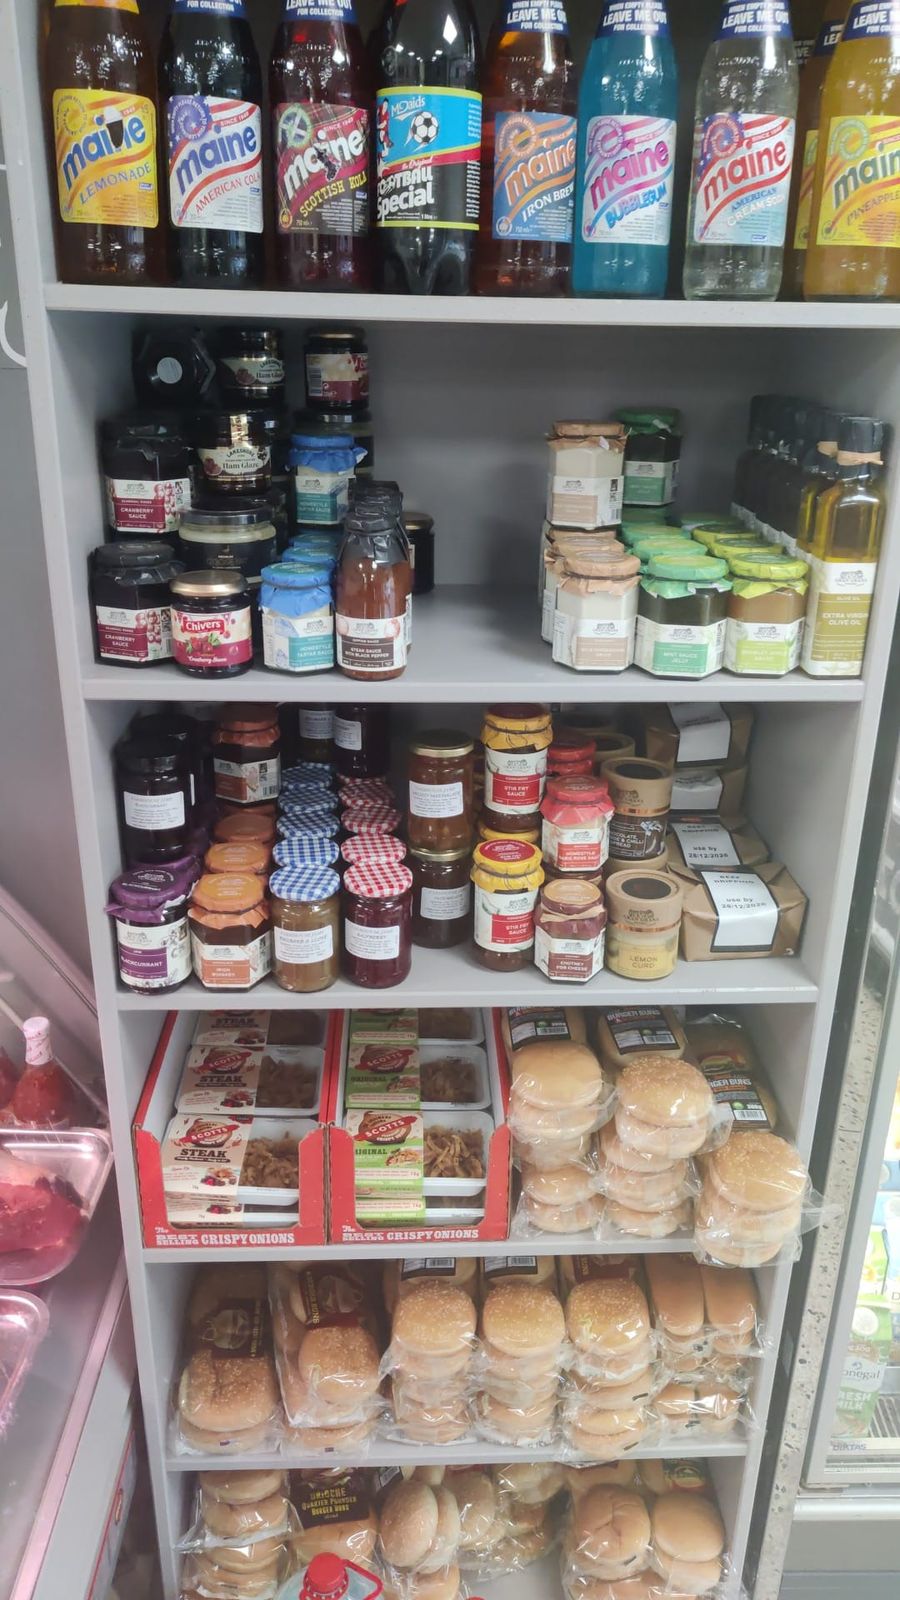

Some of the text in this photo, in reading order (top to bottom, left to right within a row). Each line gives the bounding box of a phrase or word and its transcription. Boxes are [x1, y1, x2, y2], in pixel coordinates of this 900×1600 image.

[200, 2, 235, 11] COLLECTION
[309, 9, 344, 17] COLLECTION
[507, 9, 557, 24] LEAVE ME
[603, 10, 633, 27] LEAVE
[635, 10, 652, 22] ME
[722, 11, 755, 29] LEAVE
[756, 11, 774, 22] ME
[853, 12, 887, 30] LEAVE
[220, 117, 238, 127] SINCE
[176, 124, 257, 196] maine
[505, 138, 576, 206] maine
[590, 139, 670, 211] maine
[703, 139, 786, 212] maine
[79, 162, 152, 205] LEMONADE
[195, 178, 242, 214] AMERICAN
[300, 180, 345, 218] SCOTTISH
[377, 181, 435, 227] Special
[731, 187, 777, 213] AMERICAN
[521, 192, 552, 223] IRON
[604, 181, 668, 229] BUBBLEGUM
[727, 200, 765, 227] CREAM
[847, 190, 900, 226] PINEAPPLE
[186, 620, 221, 632] Chivers
[105, 634, 136, 643] CRANBERRY
[121, 955, 163, 968] BLACKCURRANT
[607, 1009, 661, 1021] BURGER BUNS
[209, 1054, 242, 1067] SCOTTS
[367, 1052, 403, 1067] SCOTTS
[200, 1075, 243, 1083] STEAK
[710, 1078, 752, 1088] GER BUNS
[191, 1127, 229, 1140] SCOTTS
[365, 1119, 406, 1137] SCOTTS
[180, 1148, 228, 1158] STEAK
[201, 1234, 248, 1245] CRISPY
[249, 1233, 294, 1244] ONIONS
[387, 1231, 433, 1241] CRISPY
[434, 1229, 479, 1240] ONIONS
